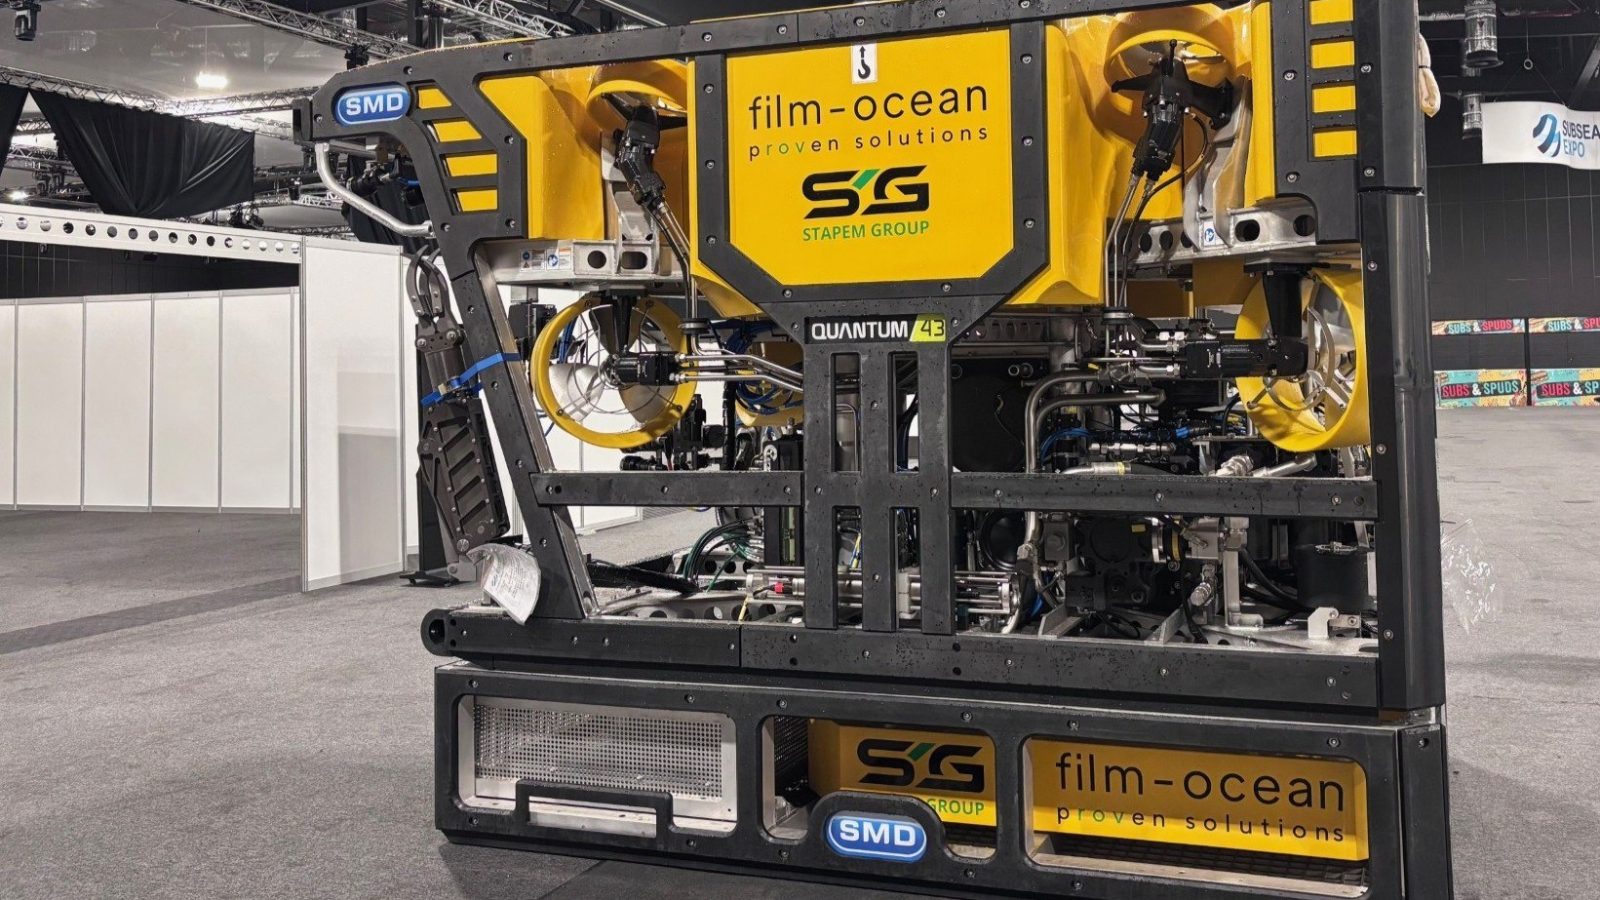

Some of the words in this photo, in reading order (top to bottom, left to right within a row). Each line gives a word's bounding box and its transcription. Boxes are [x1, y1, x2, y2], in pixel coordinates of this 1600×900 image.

[346, 93, 403, 116] SMD
[748, 84, 987, 130] film-ocean
[1562, 120, 1600, 140] SUBSEA
[749, 138, 839, 161] proven
[855, 127, 988, 149] solutions
[1563, 139, 1585, 158] EXPO
[802, 224, 865, 241] STAPEM
[871, 220, 930, 237] GROUP
[811, 320, 908, 340] QUANTUM
[920, 319, 945, 337] 43
[1448, 323, 1471, 335] SUBS
[1473, 321, 1481, 332] &
[1482, 319, 1512, 331] SPUDS
[1548, 320, 1572, 332] SUBS
[1574, 318, 1582, 330] &
[1442, 384, 1470, 397] SUBS
[1472, 382, 1482, 396] &
[1483, 380, 1519, 395] SPUDS
[1541, 382, 1571, 396] SUBS
[1572, 382, 1583, 395] &
[1055, 752, 1344, 812] film-ocean
[839, 819, 916, 847] SMD
[1057, 805, 1165, 828] proven
[1186, 813, 1344, 842] solutions
